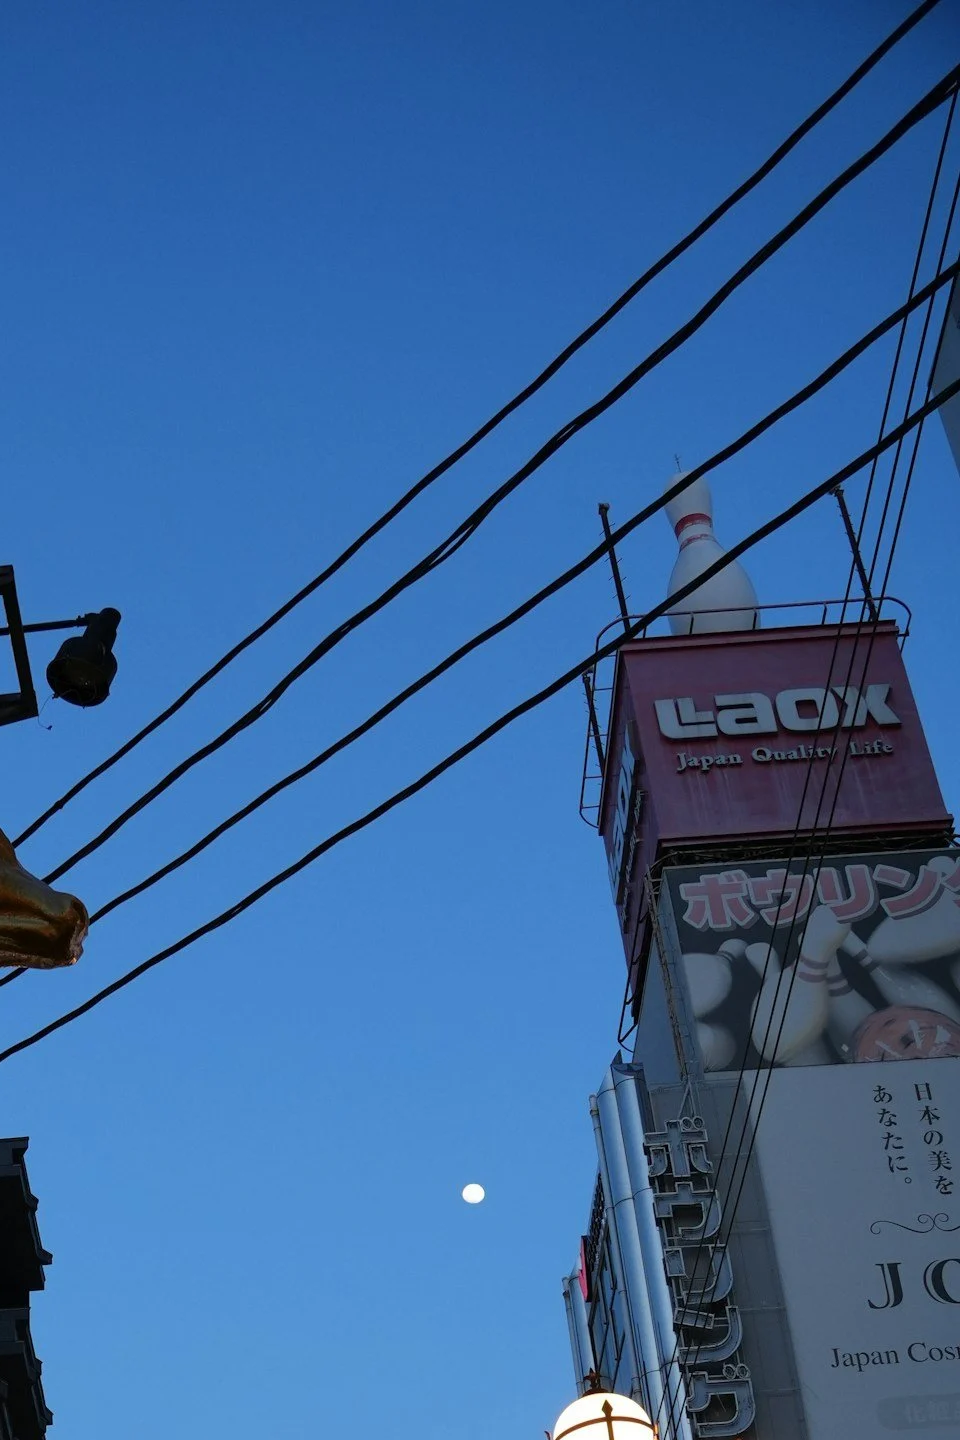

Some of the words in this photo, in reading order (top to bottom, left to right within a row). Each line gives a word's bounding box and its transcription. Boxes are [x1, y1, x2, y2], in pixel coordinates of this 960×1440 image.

[677, 745, 743, 772] Japan
[752, 741, 836, 765] Quality
[849, 738, 894, 758] Life
[679, 860, 960, 930] ボウリン
[873, 1085, 913, 1185] あなたに。
[913, 1082, 954, 1196] 日本の美を
[644, 1116, 757, 1439] ボウリング
[830, 1347, 901, 1373] Japan
